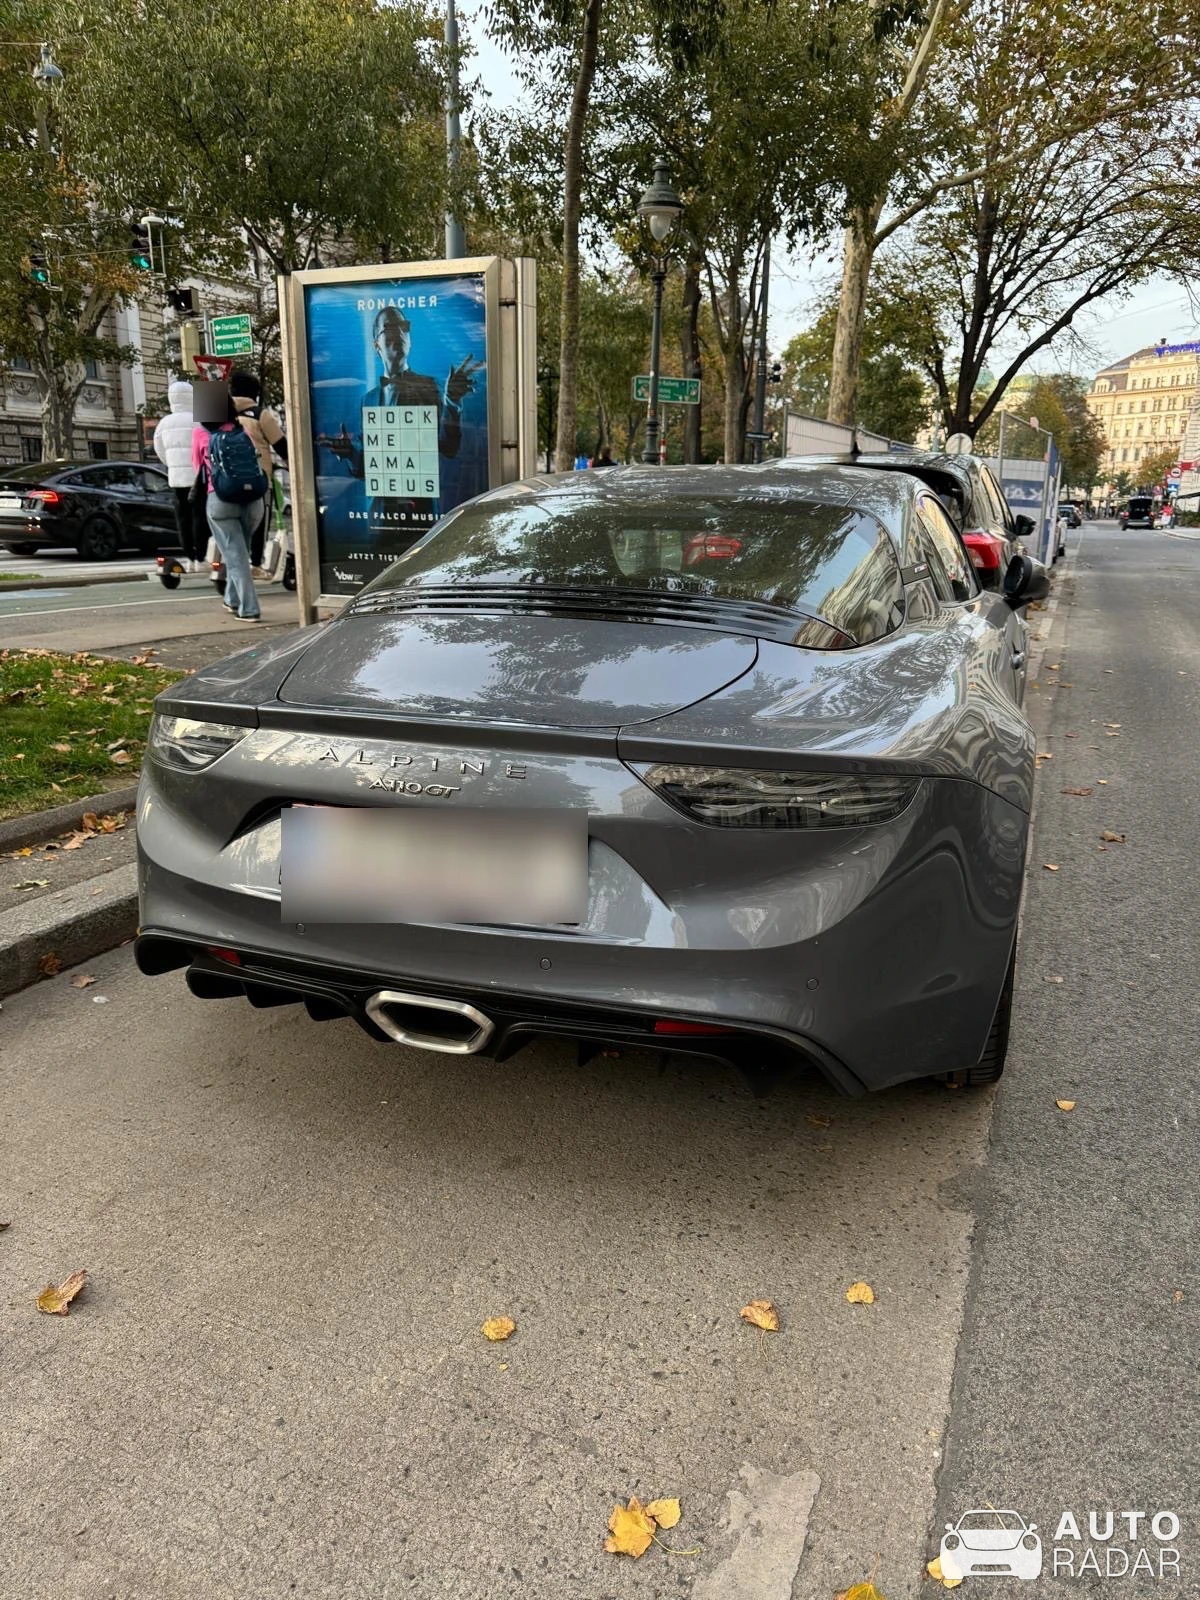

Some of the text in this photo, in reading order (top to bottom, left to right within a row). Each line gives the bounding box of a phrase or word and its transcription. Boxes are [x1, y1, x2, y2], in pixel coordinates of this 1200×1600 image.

[368, 410, 432, 424] ROCK
[367, 434, 395, 446] ME
[369, 456, 415, 469] AMA
[370, 478, 434, 492] DEUS
[348, 511, 369, 519] DAS
[374, 511, 406, 520] FALCO
[320, 748, 527, 779] ALPINE
